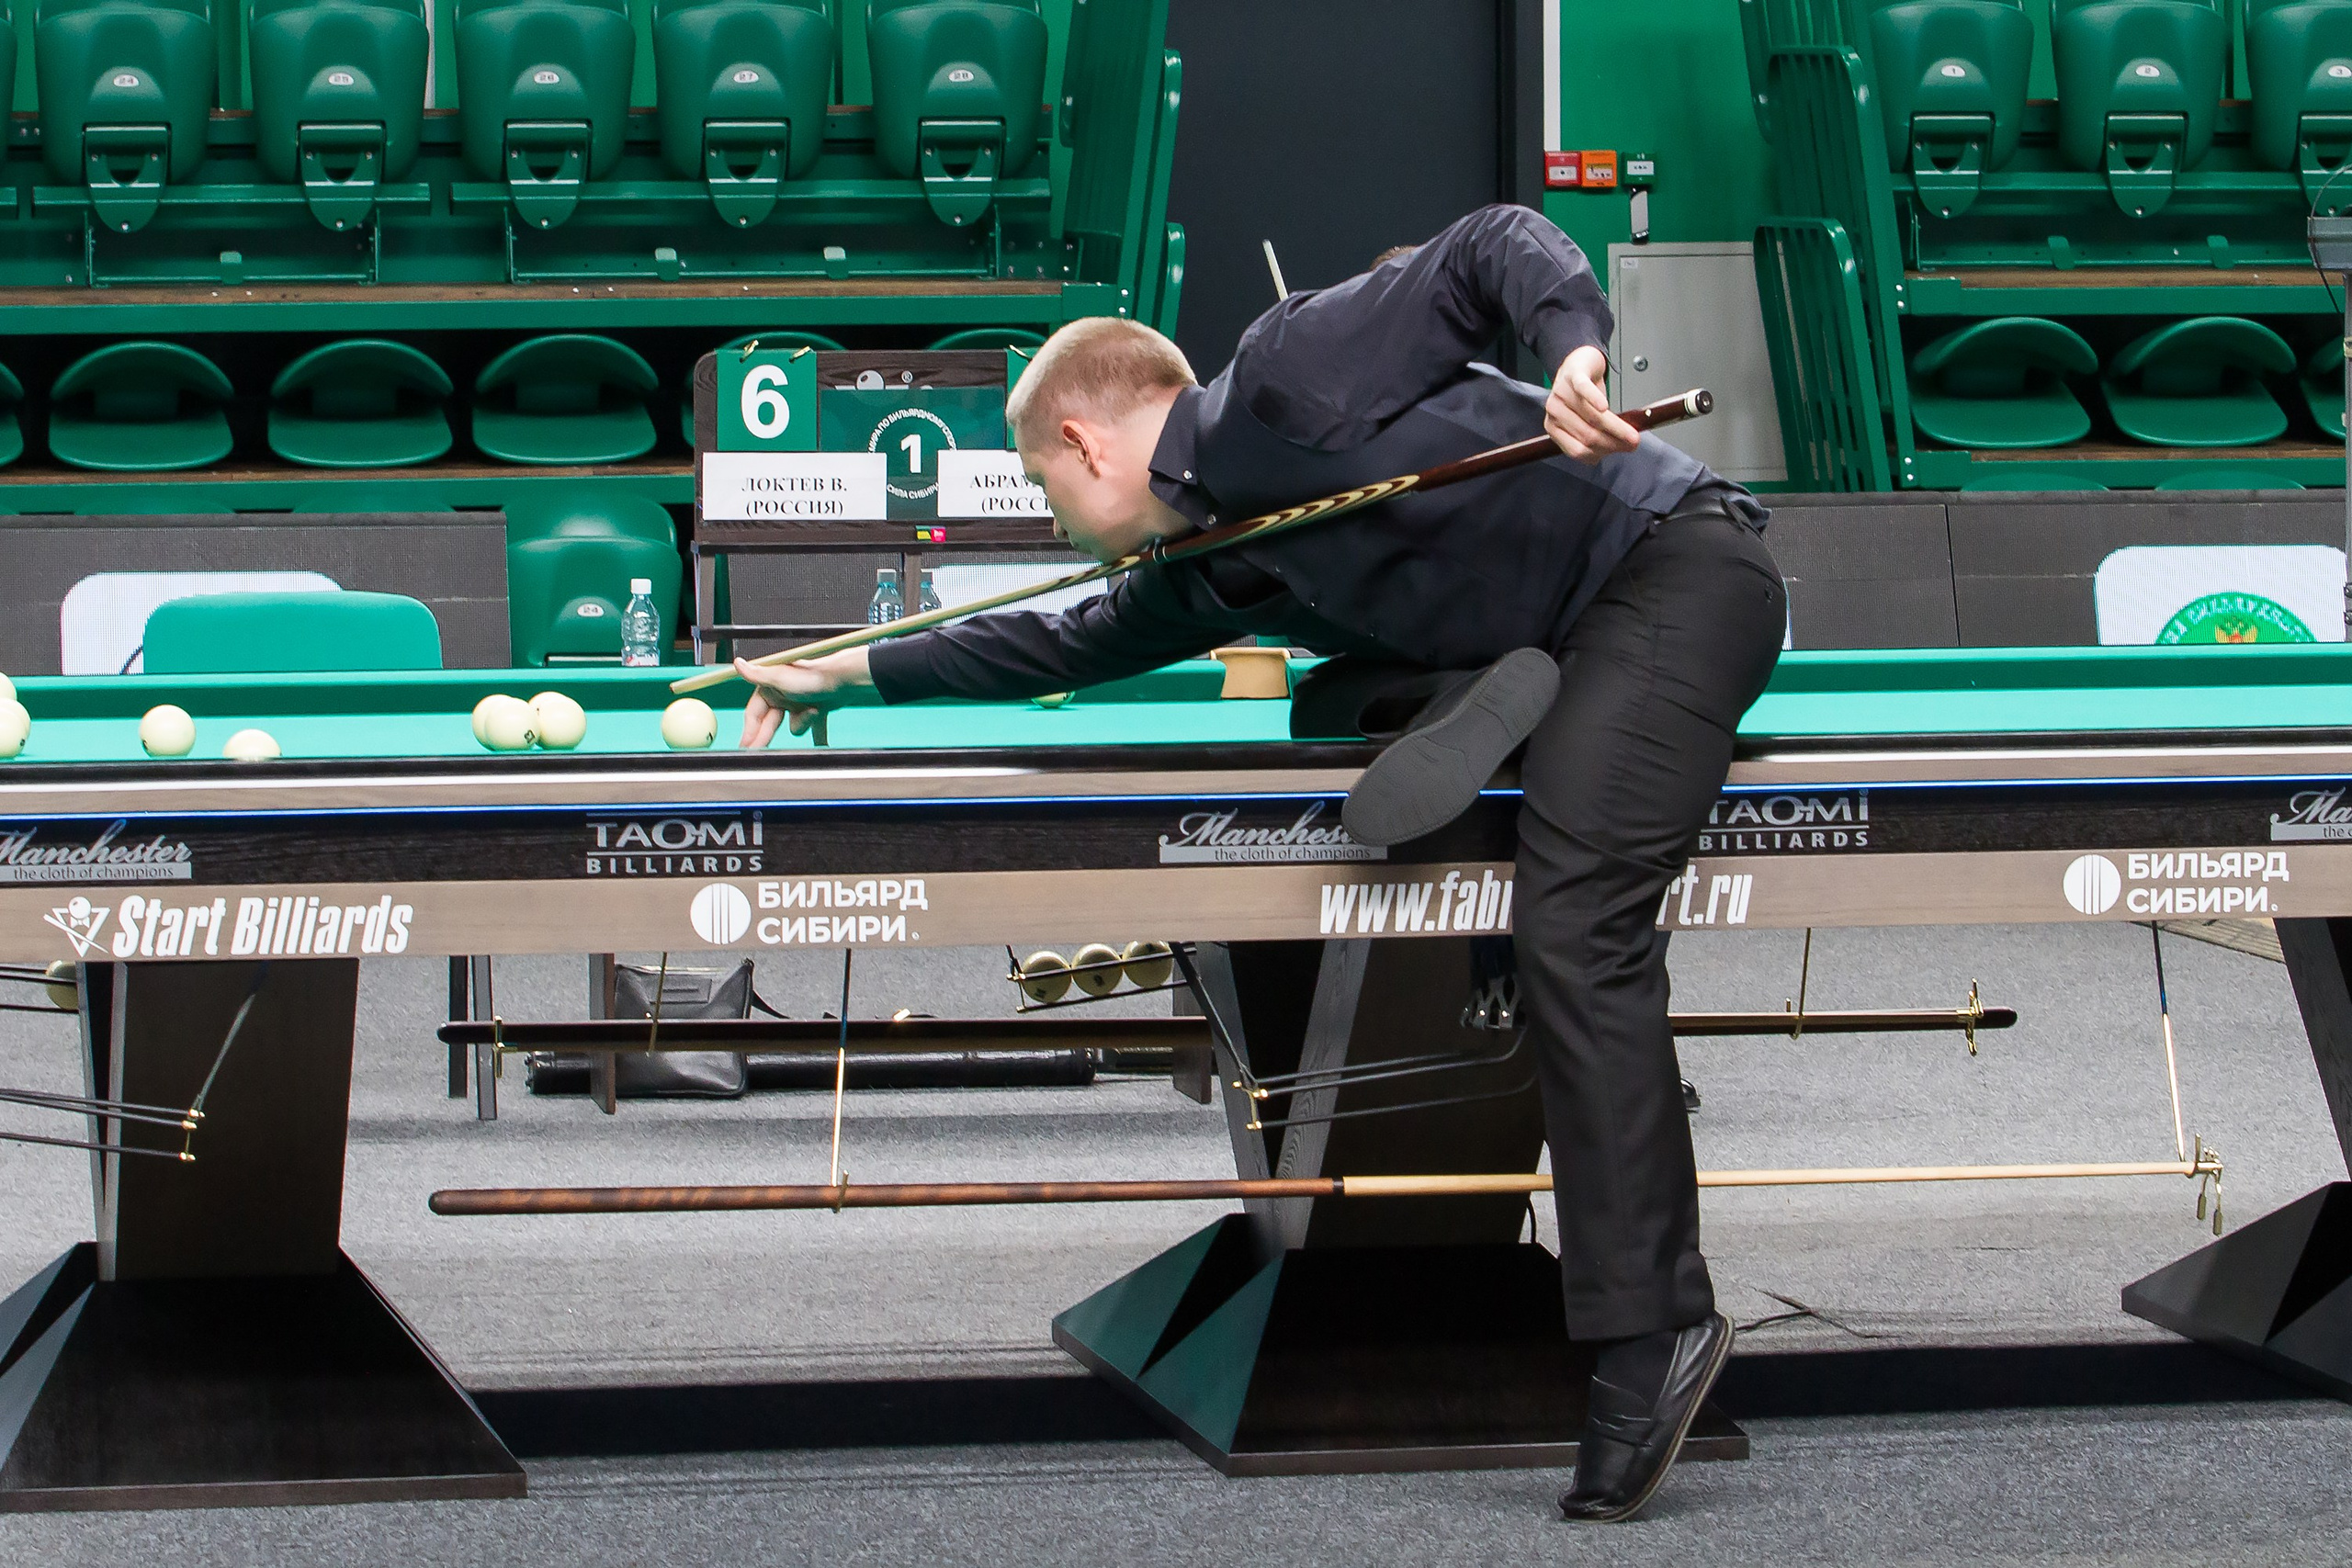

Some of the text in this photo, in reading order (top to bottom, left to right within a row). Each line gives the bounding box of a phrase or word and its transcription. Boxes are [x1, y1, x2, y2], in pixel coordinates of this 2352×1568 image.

[741, 365, 789, 438] 6
[900, 434, 922, 474] 1
[741, 478, 847, 491] ЛОКТЕВ В.
[746, 500, 843, 518] (РОССИЯ)
[1159, 800, 1352, 846] Manches
[2323, 826, 2345, 838] the
[0, 818, 192, 865] Manchester
[1215, 845, 1371, 861] the cloth of champions
[1699, 831, 1868, 851] BILLIARDS
[14, 865, 174, 881] the cloth of champions
[586, 855, 763, 874] BILLIARDS
[2128, 852, 2290, 882] БИЛЬЯРД
[758, 879, 928, 910] БИЛЬЯРД
[112, 895, 413, 958] Start Billiards
